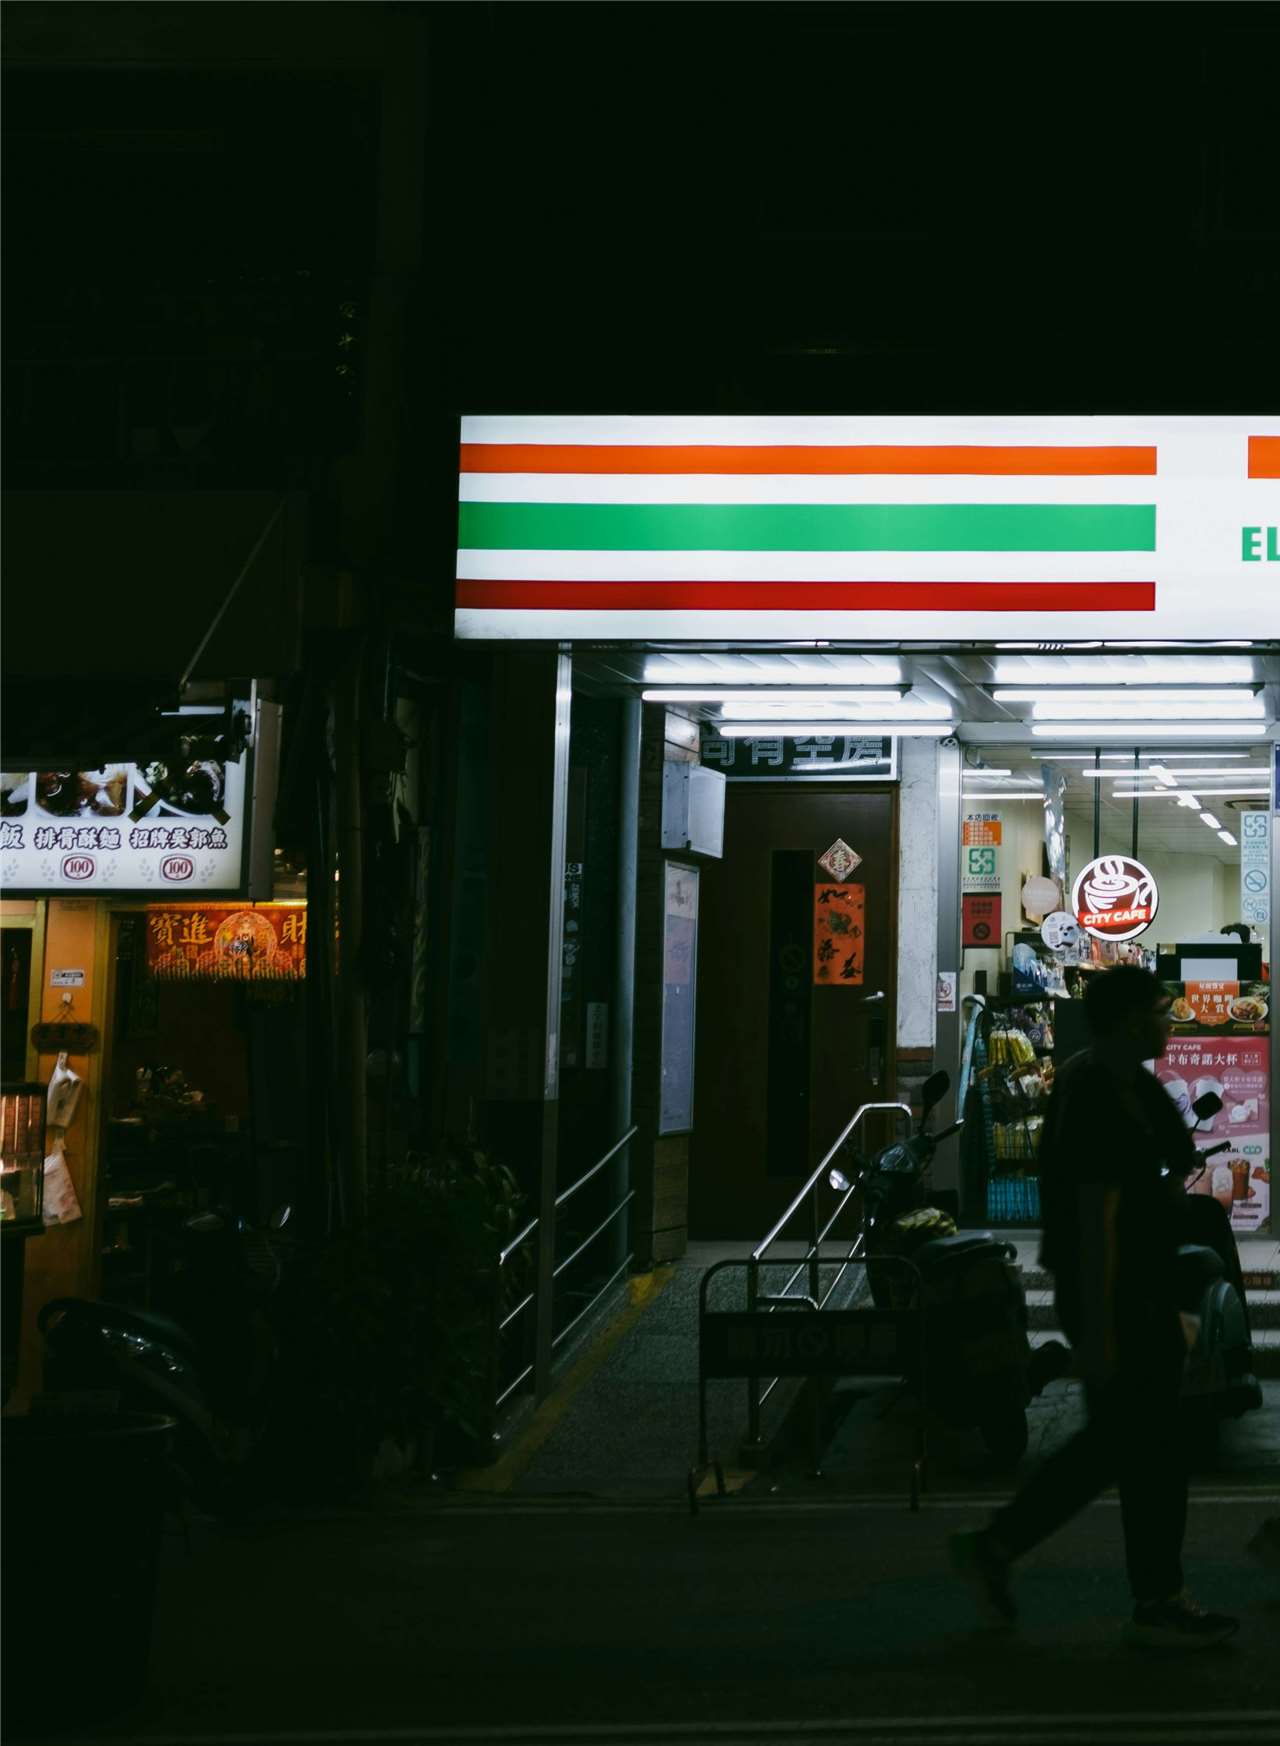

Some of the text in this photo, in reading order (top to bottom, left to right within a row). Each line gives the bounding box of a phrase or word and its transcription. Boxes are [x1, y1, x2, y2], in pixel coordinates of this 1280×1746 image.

[34, 826, 121, 850] 排骨酥麵
[129, 826, 229, 850] 招牌吳郭魚
[69, 862, 187, 873] 100 100
[1083, 909, 1146, 925] CITY CAFE
